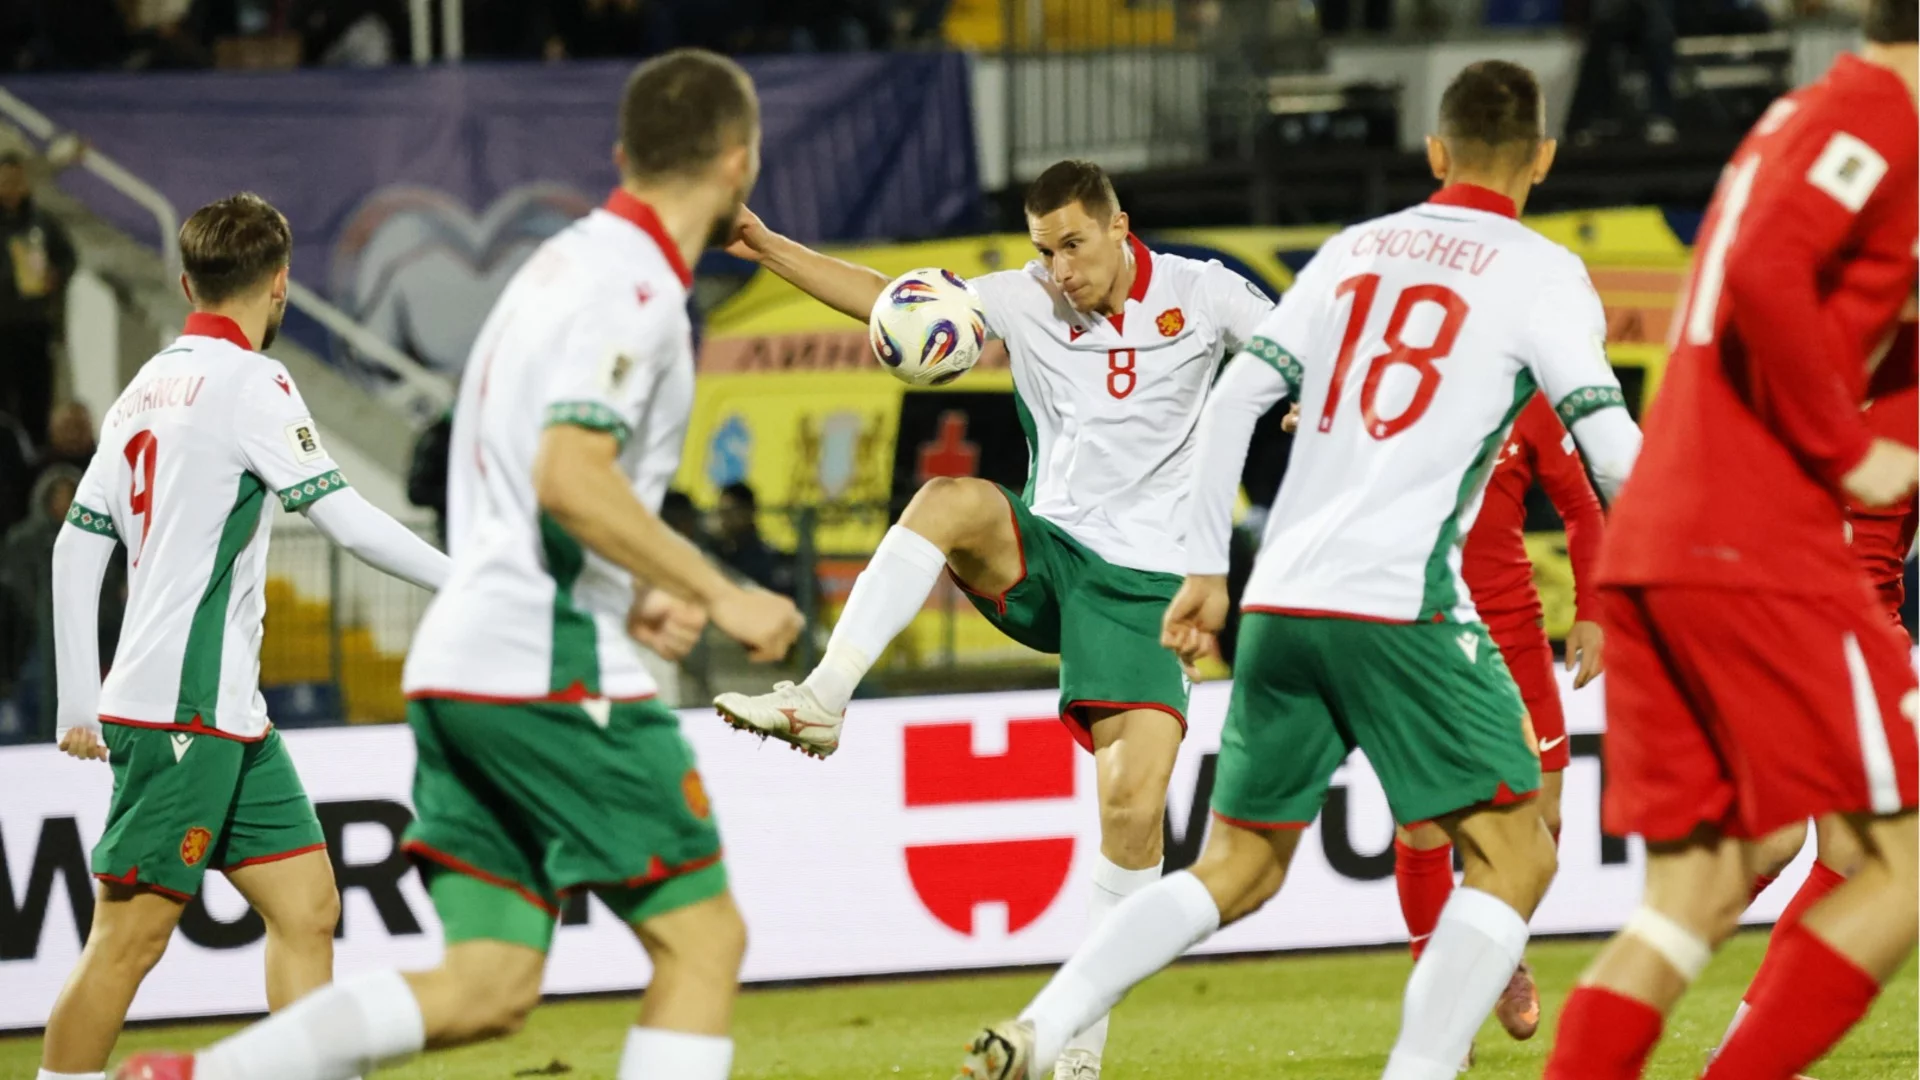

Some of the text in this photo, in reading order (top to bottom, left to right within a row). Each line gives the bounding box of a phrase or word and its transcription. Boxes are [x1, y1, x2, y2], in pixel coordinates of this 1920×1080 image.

[1352, 229, 1500, 276] CHOCHEV
[1107, 347, 1137, 400] 8
[1318, 273, 1471, 440] 18
[123, 428, 158, 569] 9
